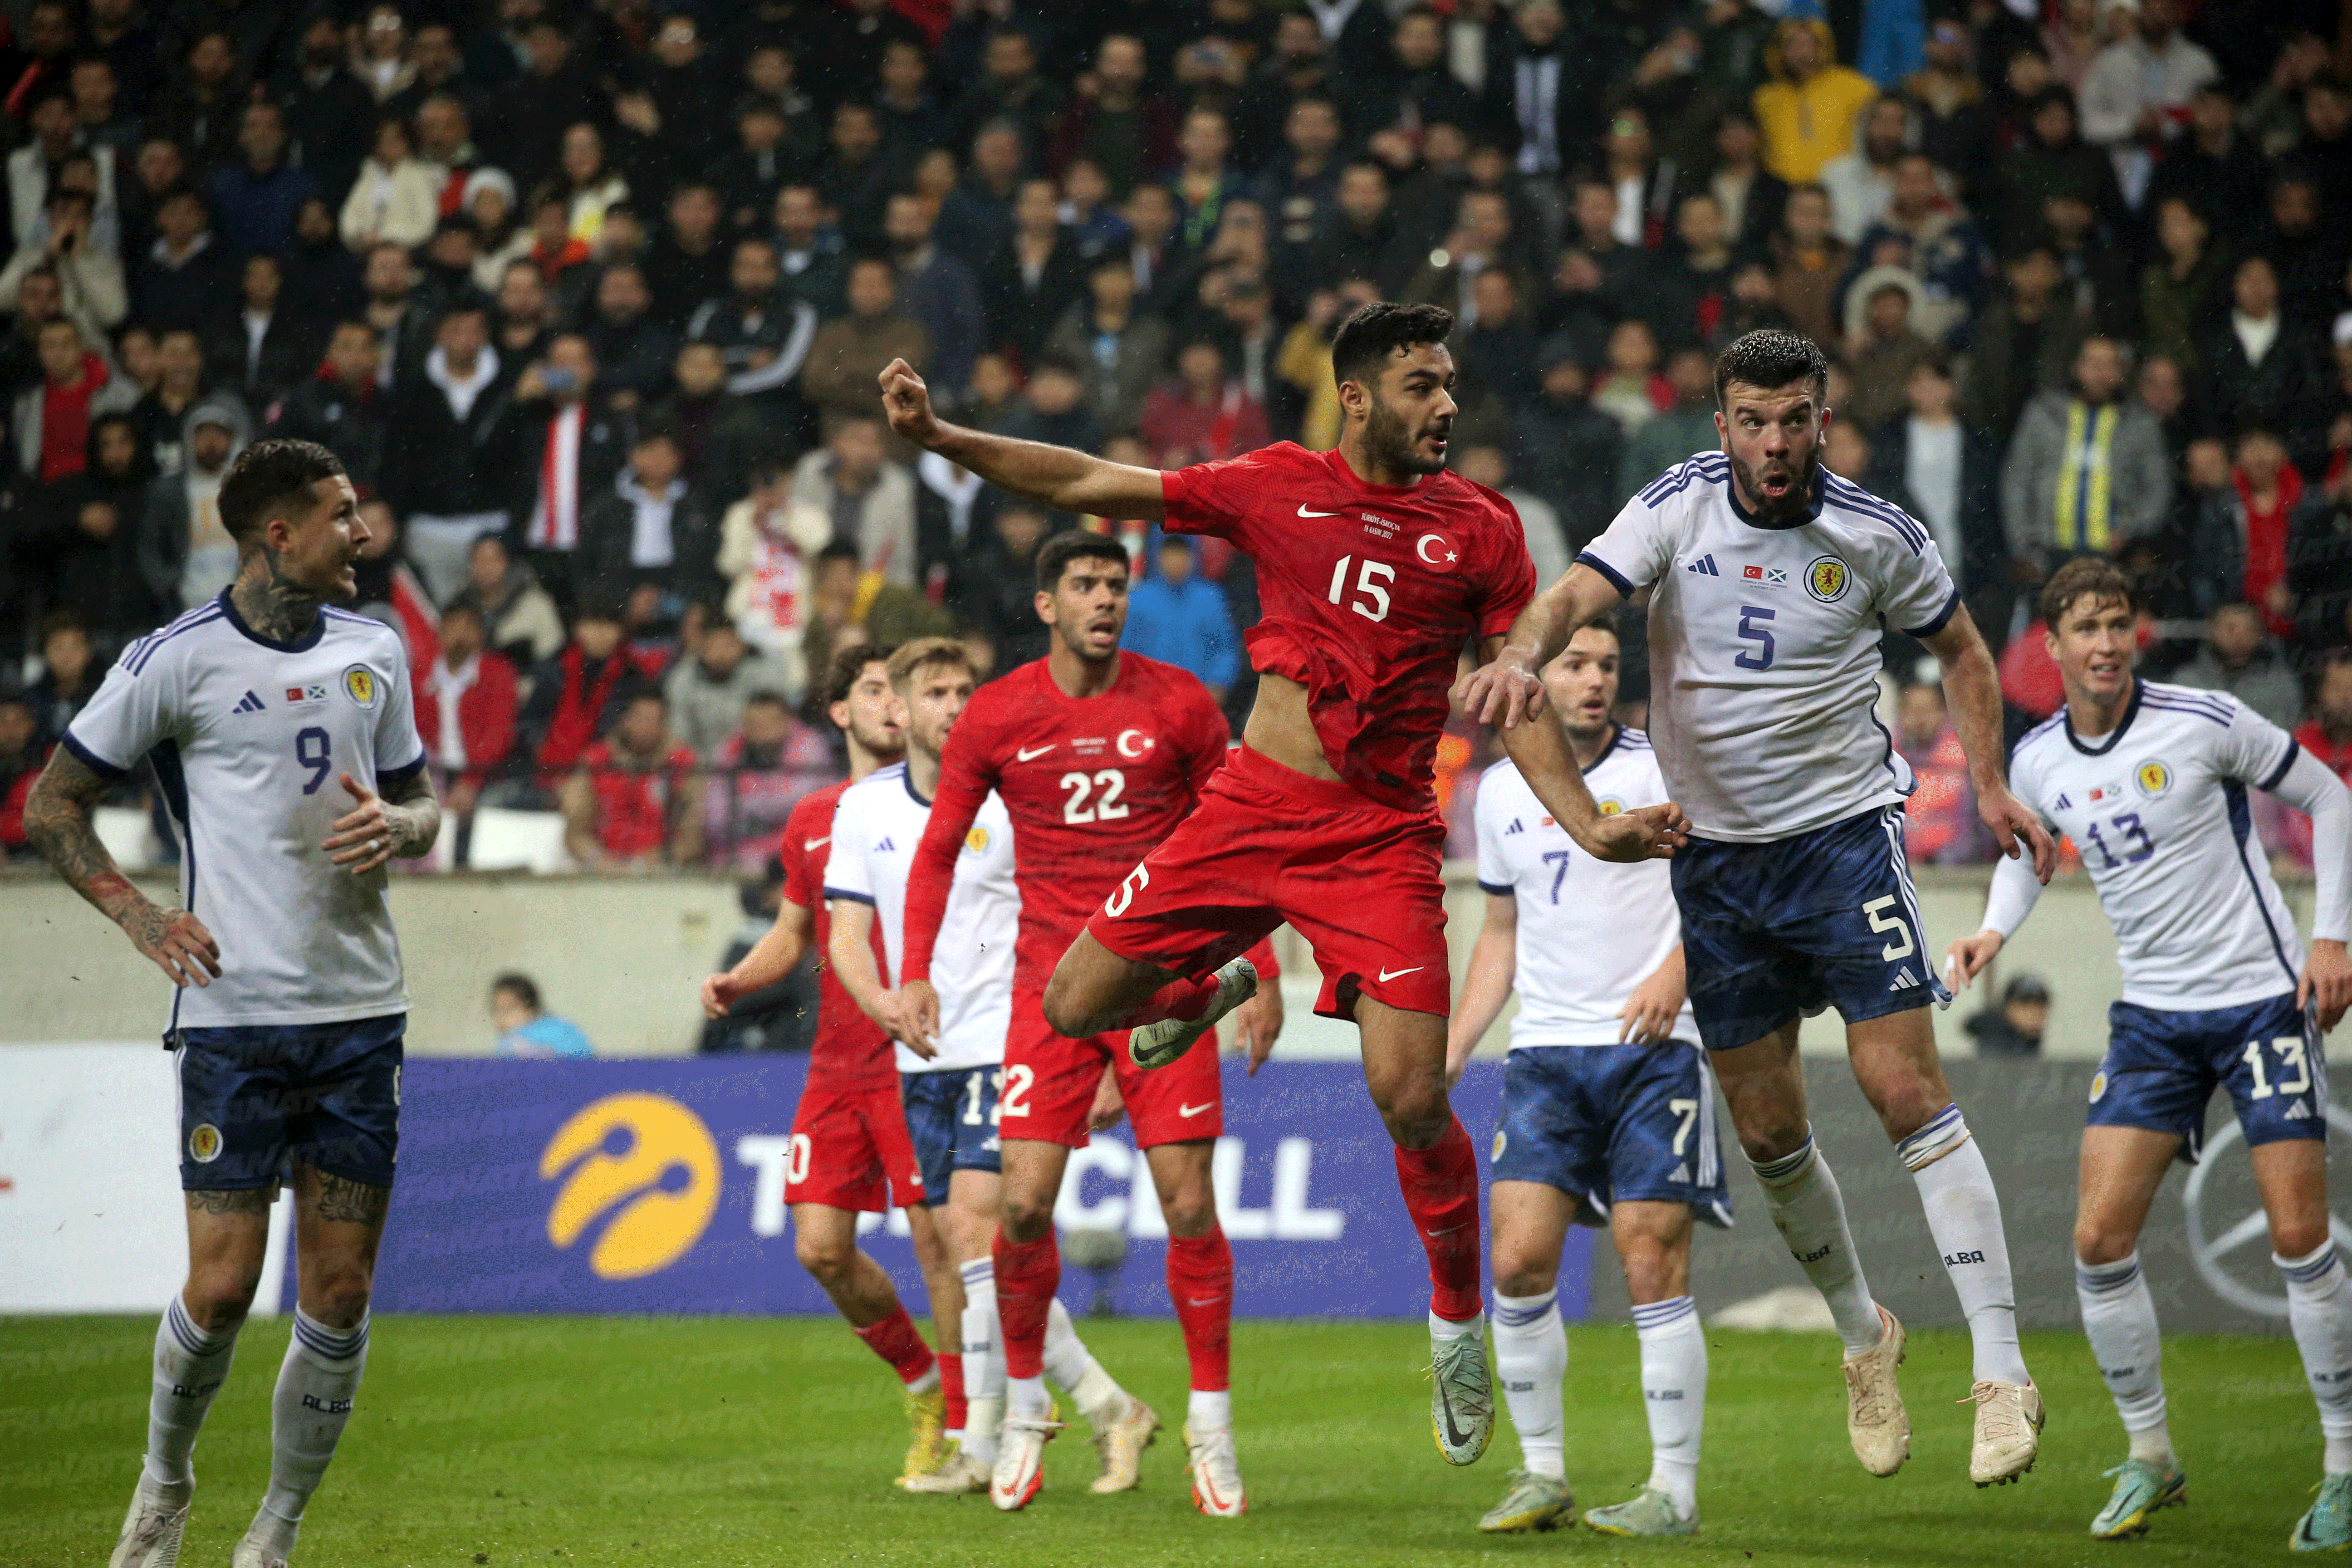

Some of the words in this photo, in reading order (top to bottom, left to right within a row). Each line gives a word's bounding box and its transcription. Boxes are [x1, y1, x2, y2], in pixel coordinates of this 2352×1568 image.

[1328, 554, 1396, 623] 15
[1735, 605, 1776, 670] 5
[296, 726, 332, 795] 9
[1060, 769, 1129, 824] 22
[2087, 813, 2155, 869] 13
[1543, 851, 1569, 905] 7
[1862, 894, 1914, 962] 5
[1000, 1064, 1034, 1117] 2
[2242, 1036, 2311, 1100] 13
[1669, 1098, 1698, 1156] 7
[1944, 1250, 1985, 1269] ALBA
[302, 1394, 352, 1414] ALBA
